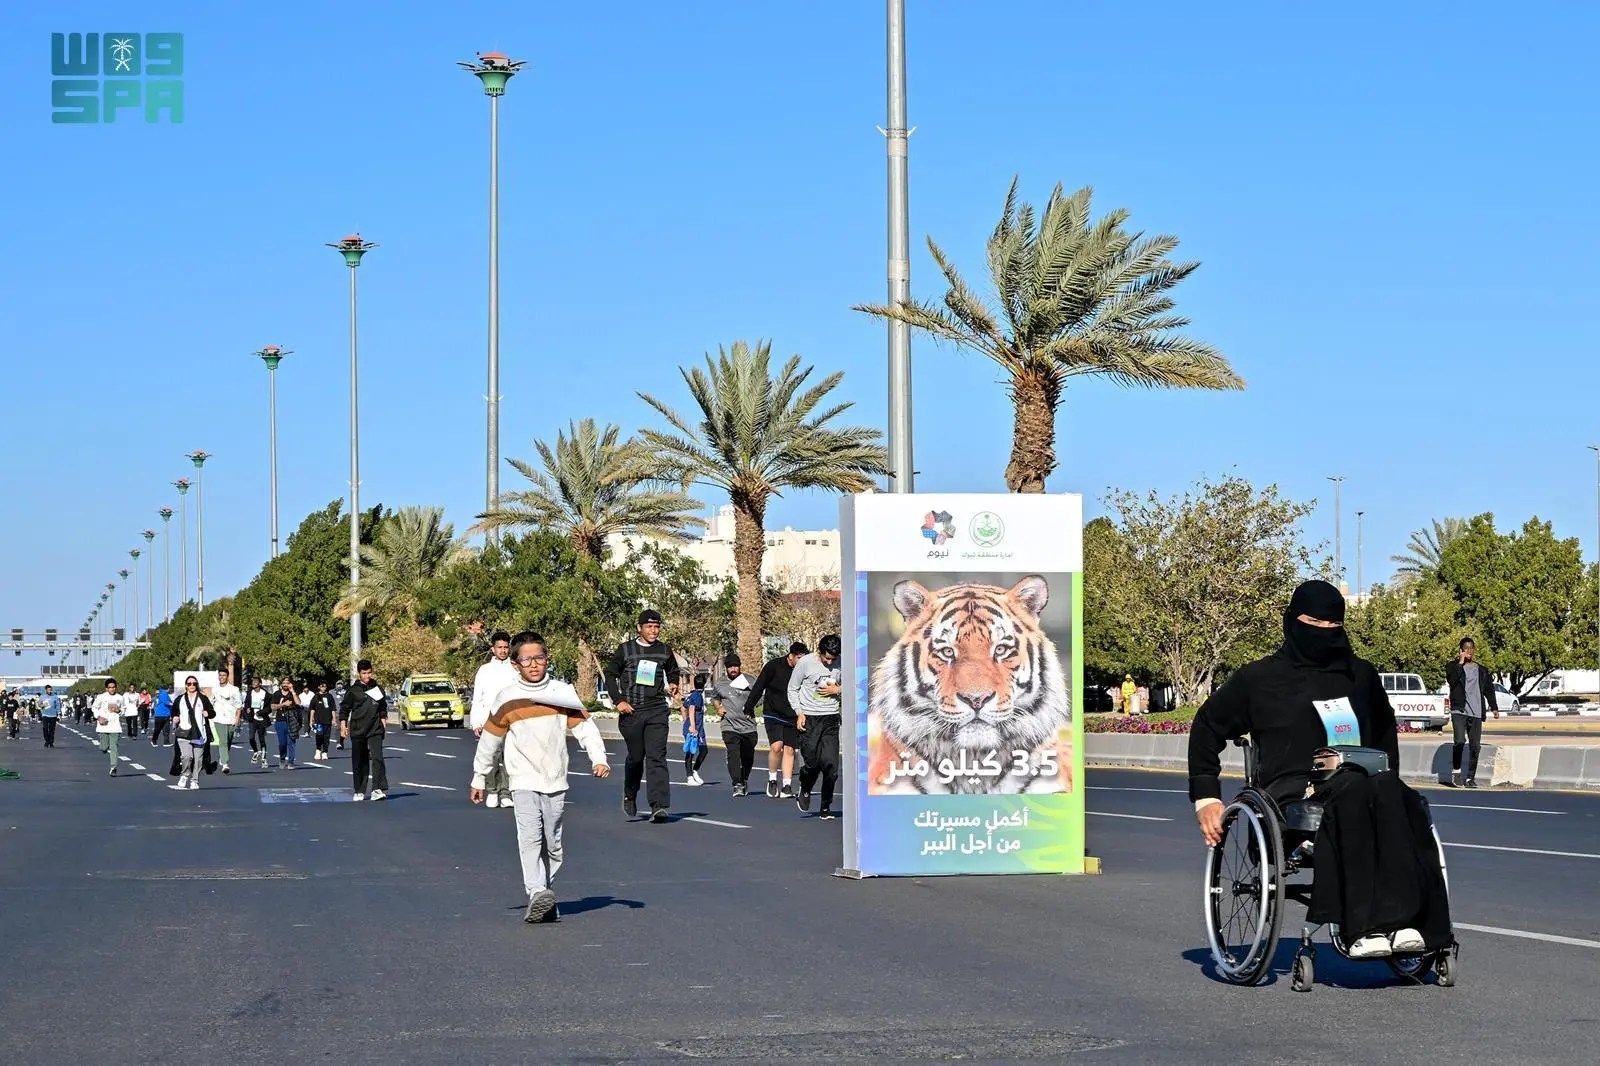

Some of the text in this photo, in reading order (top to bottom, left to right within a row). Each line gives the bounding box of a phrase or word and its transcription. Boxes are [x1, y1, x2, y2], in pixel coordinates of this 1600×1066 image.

[927, 549, 949, 558] نيوم
[1397, 703, 1436, 712] TOYOTA
[1334, 724, 1352, 733] 0075
[884, 749, 1058, 785] 3.5 كيلو متر
[914, 807, 1030, 832] أكمل مسيرتك
[920, 831, 1021, 856] من أجل الببر
